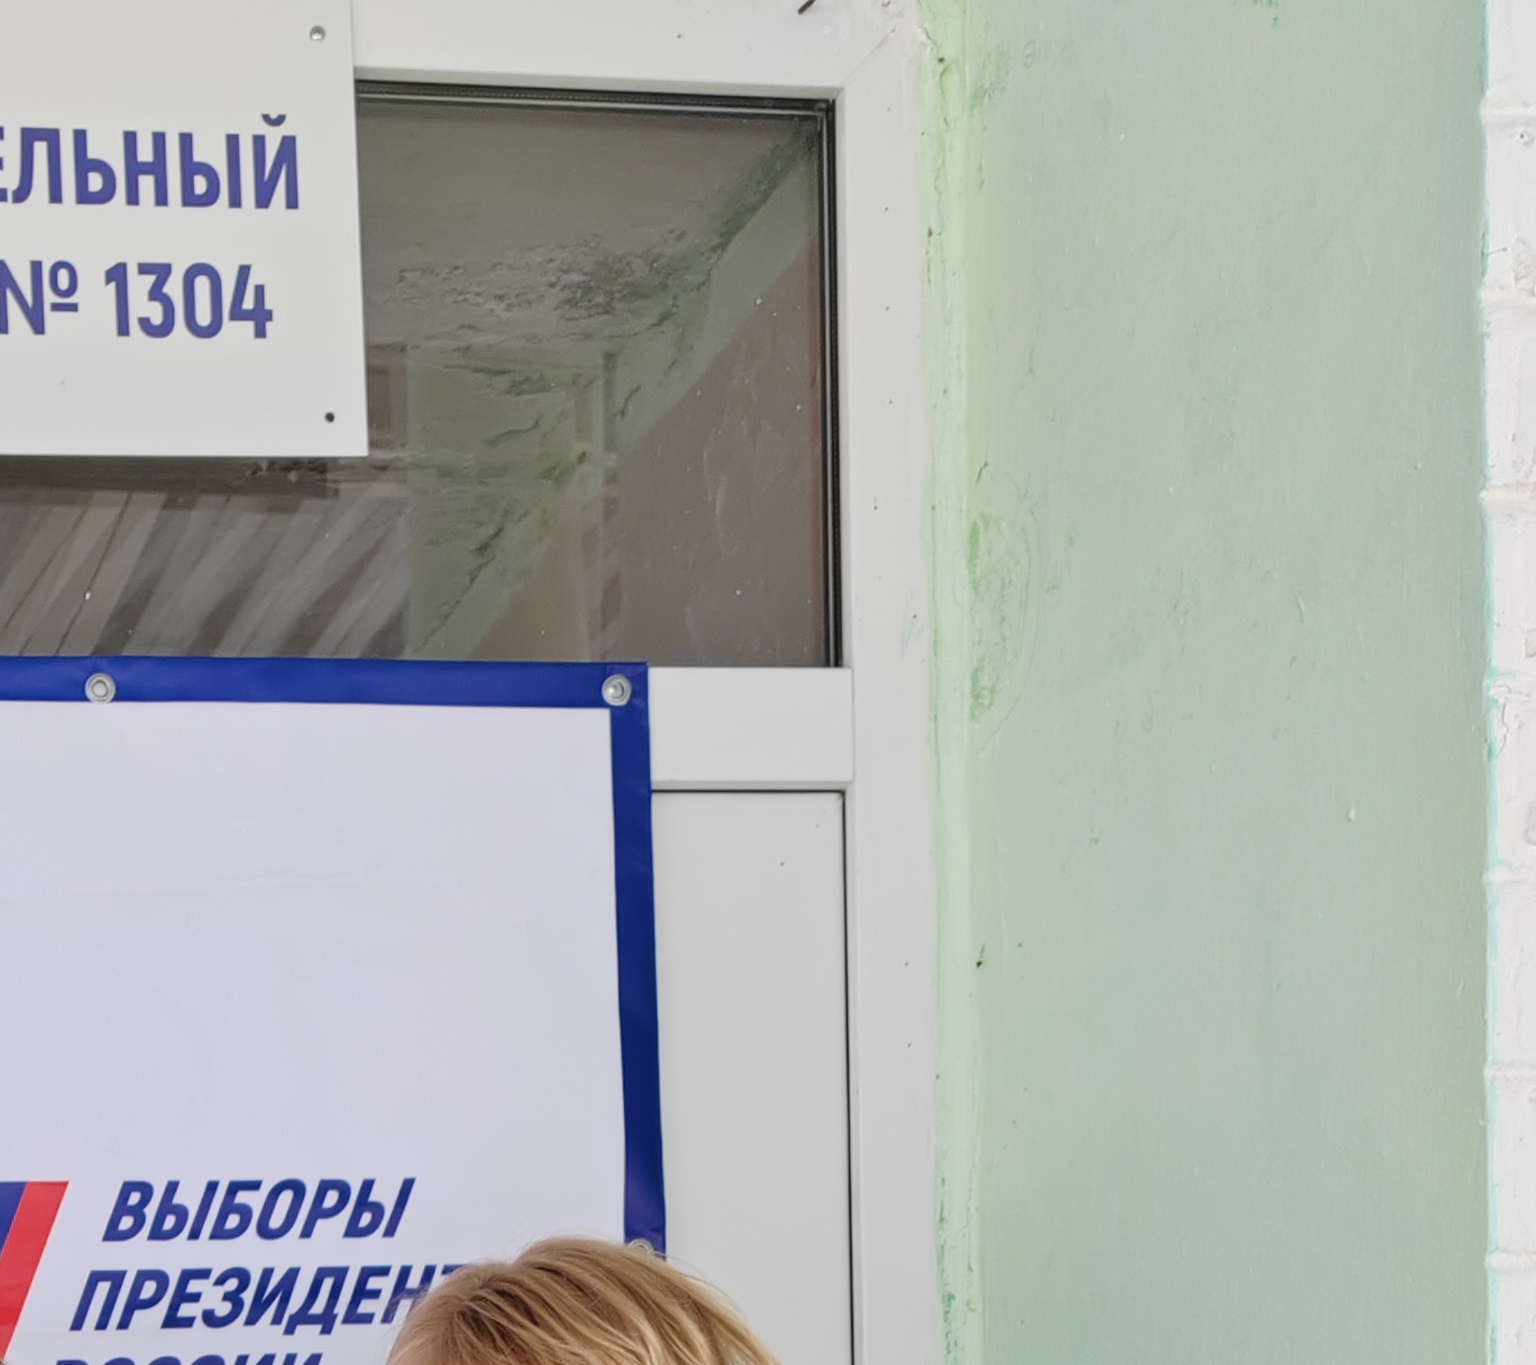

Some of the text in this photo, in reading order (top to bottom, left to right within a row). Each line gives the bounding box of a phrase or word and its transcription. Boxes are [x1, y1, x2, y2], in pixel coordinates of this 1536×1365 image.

[105, 262, 273, 339] 1304
[102, 1177, 416, 1242] ВЫБОРЫ
[70, 1264, 467, 1336] ПРЕЗИДЕН
